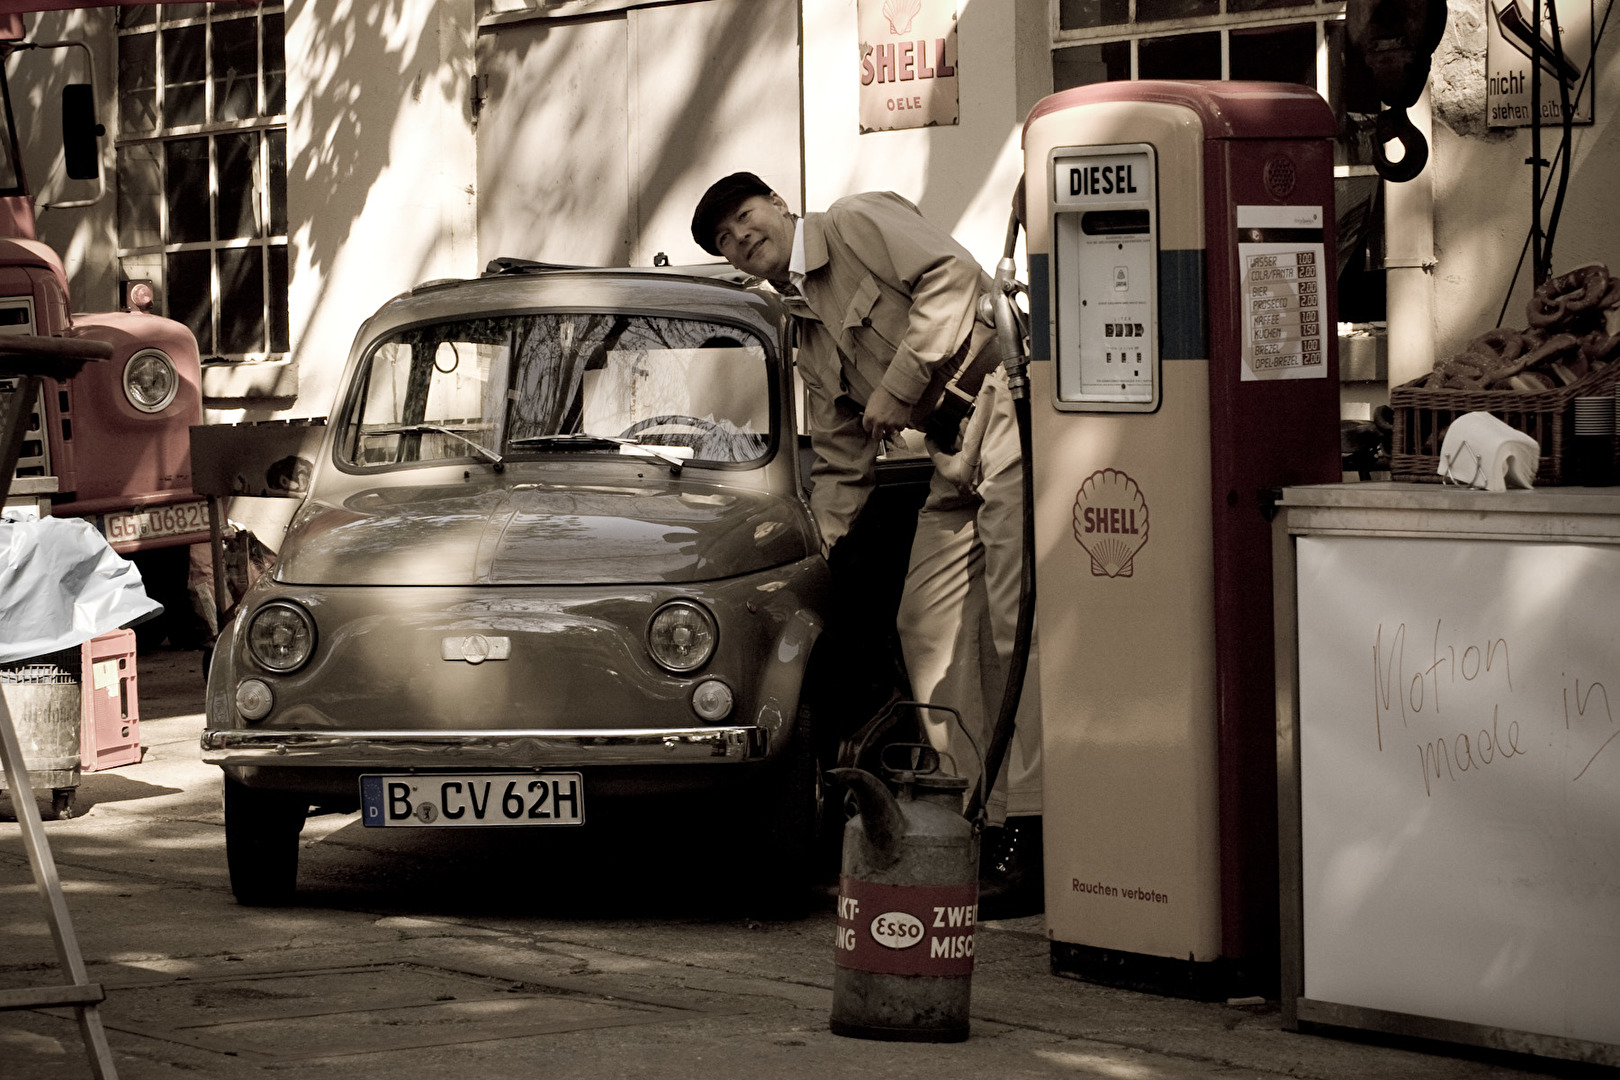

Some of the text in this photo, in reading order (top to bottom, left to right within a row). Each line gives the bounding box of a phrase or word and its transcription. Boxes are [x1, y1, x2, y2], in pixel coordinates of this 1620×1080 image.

[861, 38, 955, 86] SHELL
[1489, 70, 1525, 95] nicht
[886, 97, 922, 111] OELE
[1492, 102, 1530, 119] stehen
[1070, 164, 1137, 196] DIESEL
[1250, 255, 1277, 268] WASSER
[1251, 268, 1294, 281] COLA/FANTA
[1252, 286, 1268, 297] BIER
[1252, 298, 1288, 310] PROSECCO
[1253, 314, 1280, 326] KAFFEE
[1254, 328, 1282, 340] KUCHEN
[1254, 344, 1280, 356] BREZEL
[1255, 355, 1299, 369] OPEL-BREZEL
[109, 514, 136, 538] GG
[1084, 507, 1139, 535] SHELL
[1373, 619, 1512, 752] Motion
[1417, 671, 1612, 797] made in
[369, 780, 578, 820] D B CV 62H
[1072, 878, 1168, 904] Rauchen verboten
[836, 926, 856, 951] NG
[930, 935, 975, 959] MISC
